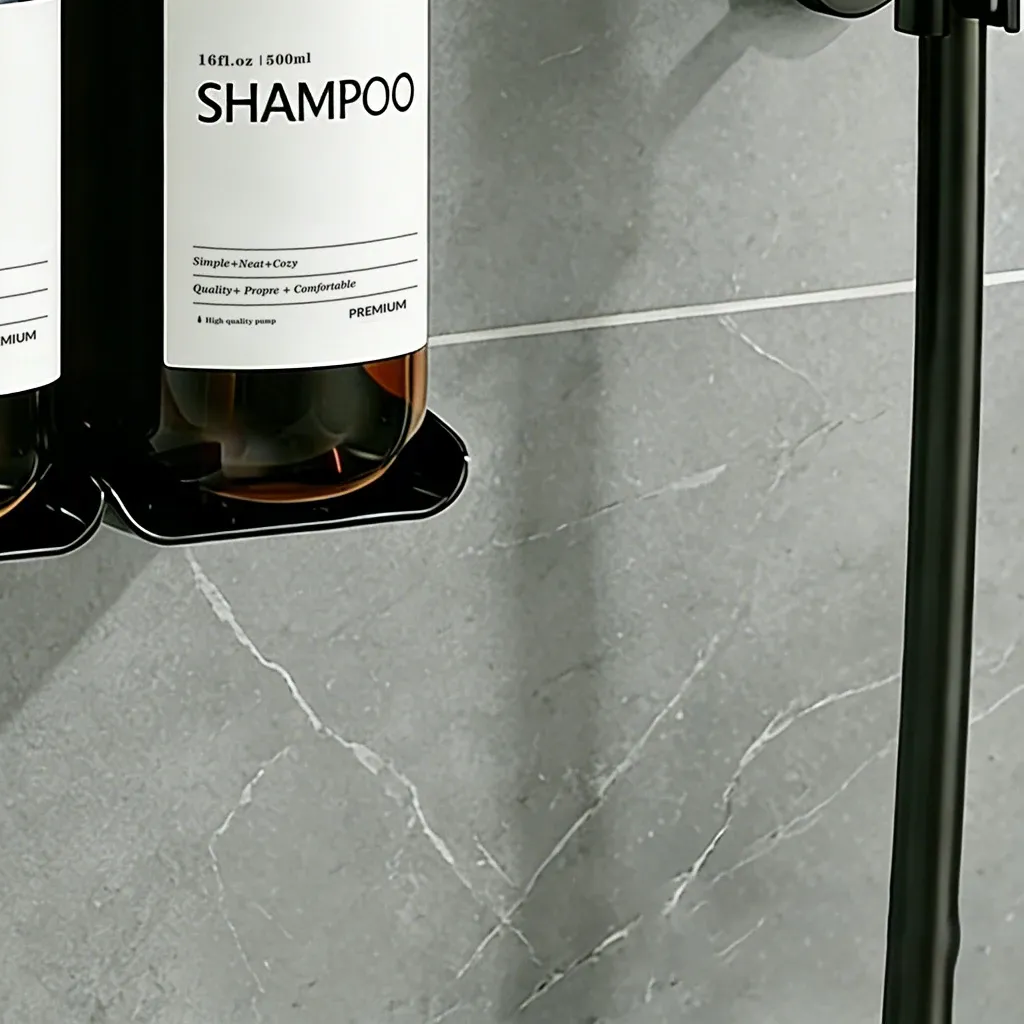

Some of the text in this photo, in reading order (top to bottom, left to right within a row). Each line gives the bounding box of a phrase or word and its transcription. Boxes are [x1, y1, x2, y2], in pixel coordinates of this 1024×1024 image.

[199, 54, 253, 66] 16fl.oz
[266, 52, 311, 66] 500ml
[198, 72, 414, 123] SHAMPOO
[193, 284, 240, 296] Quality+
[244, 286, 279, 296] Propre
[294, 280, 356, 294] Comfortable
[349, 299, 406, 318] PREMIUM
[206, 317, 224, 326] High
[226, 318, 253, 326] quality
